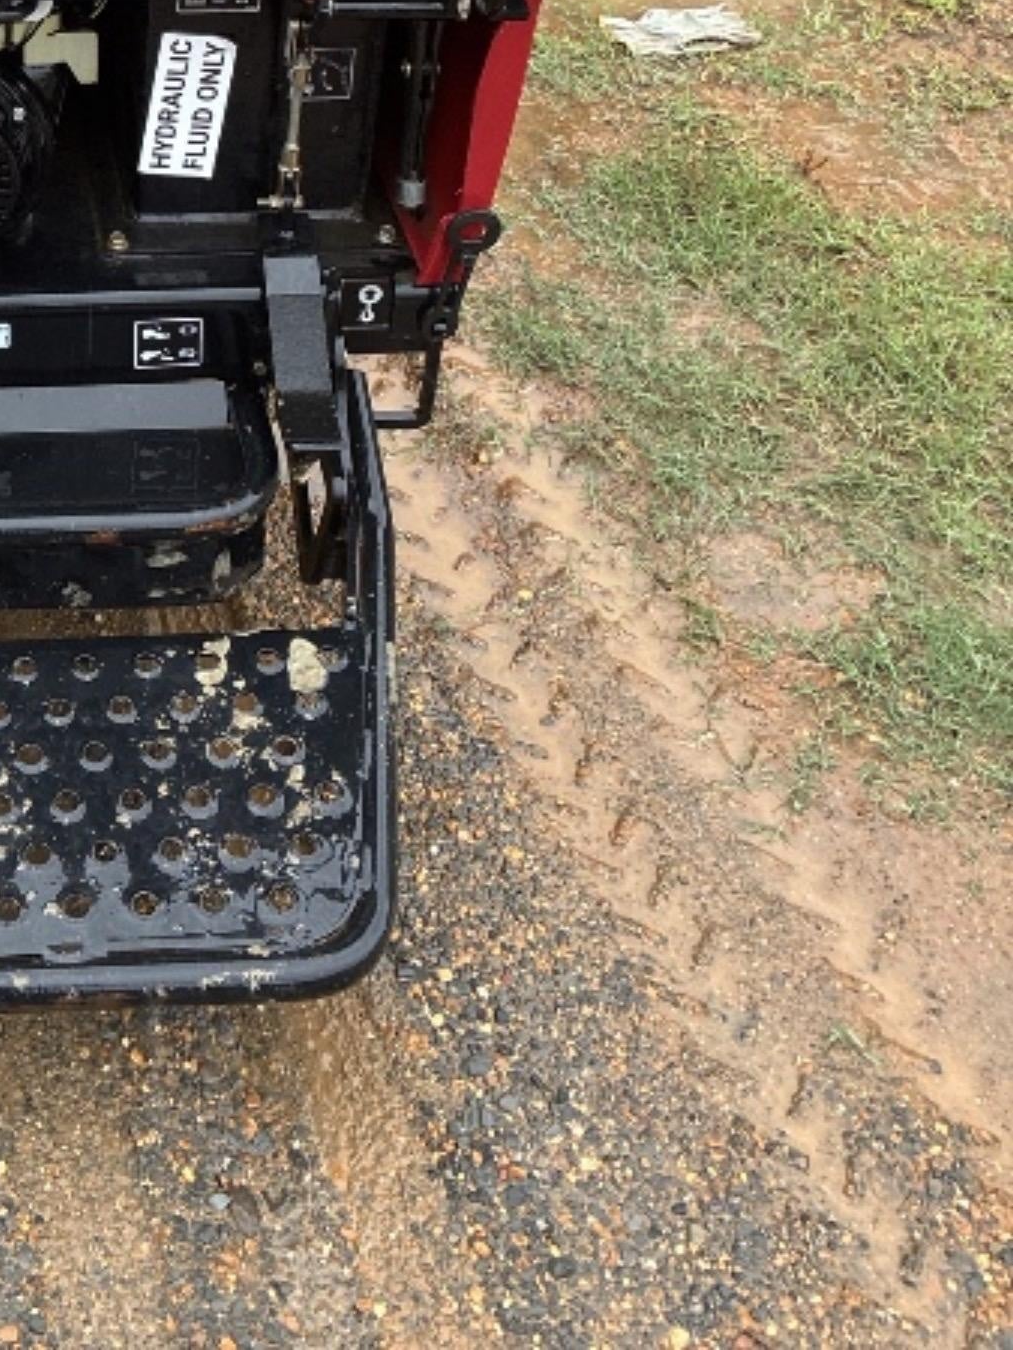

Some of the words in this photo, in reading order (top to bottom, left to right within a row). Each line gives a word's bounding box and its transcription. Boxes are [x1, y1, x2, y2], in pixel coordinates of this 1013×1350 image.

[197, 41, 226, 101] ONLY
[149, 38, 192, 169] HYDRAULIC
[182, 107, 213, 171] FLUID
